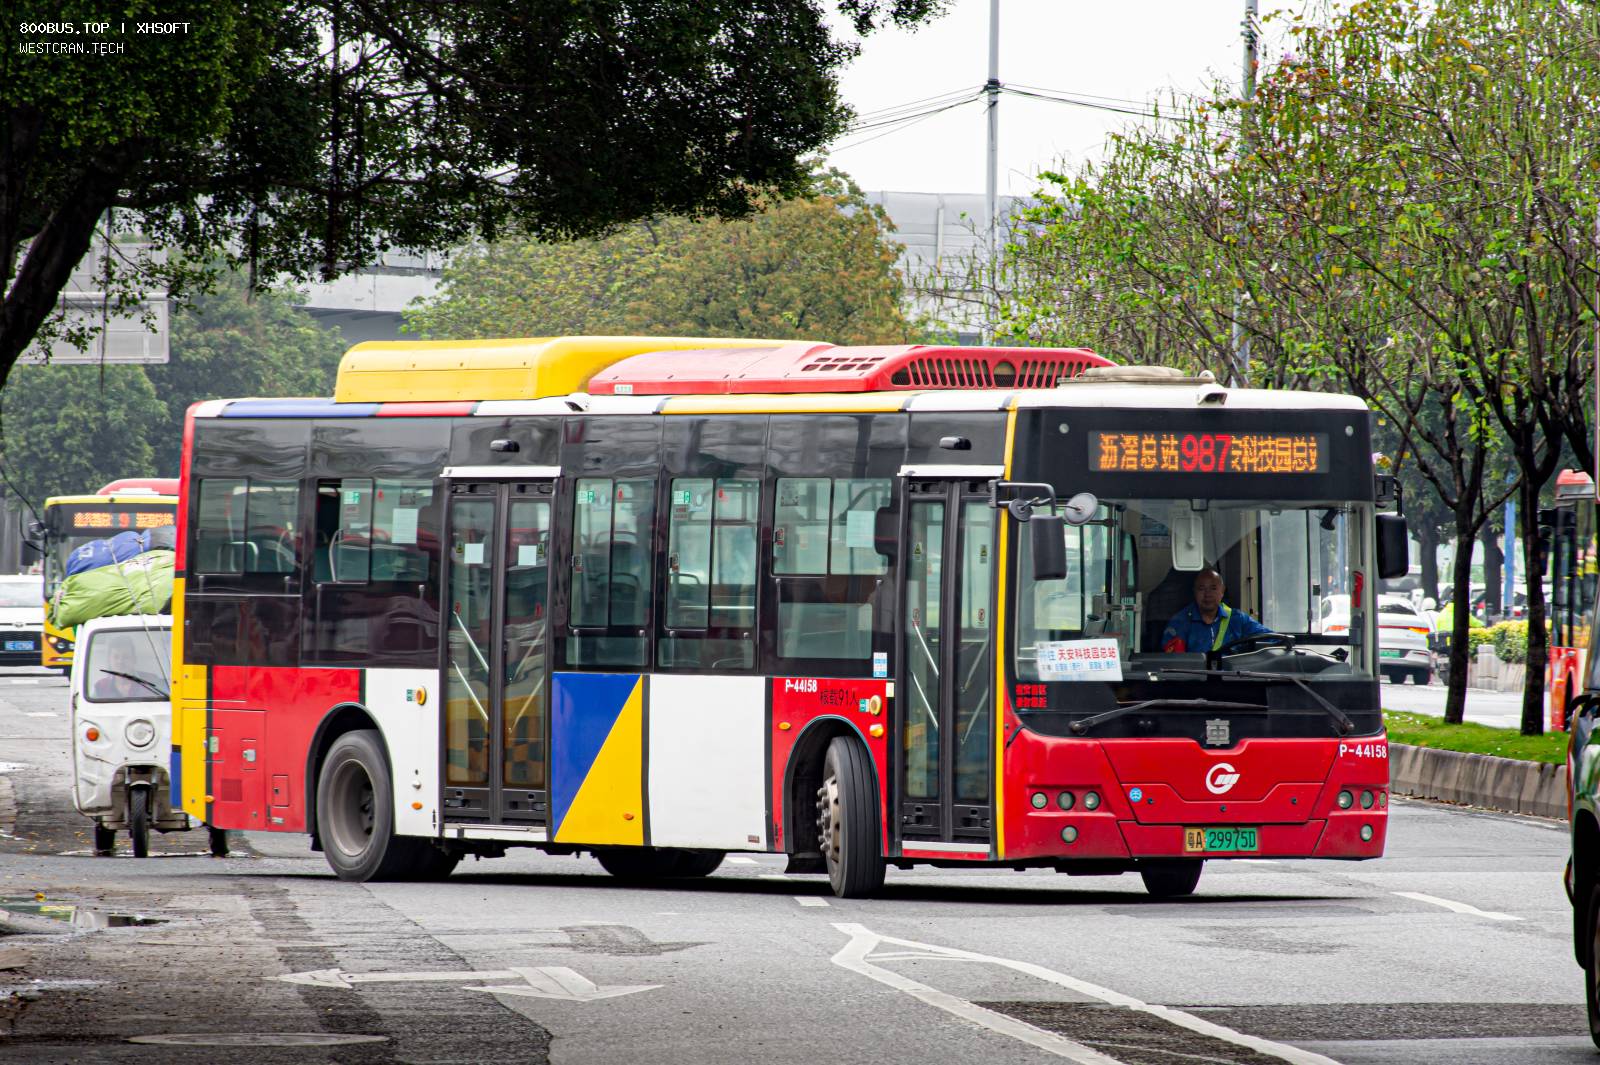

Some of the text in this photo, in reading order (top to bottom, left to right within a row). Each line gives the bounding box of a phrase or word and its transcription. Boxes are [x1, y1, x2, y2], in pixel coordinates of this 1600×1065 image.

[1181, 434, 1231, 472] 987
[785, 679, 817, 692] P-44158
[1339, 744, 1387, 758] P-44158
[1209, 831, 1256, 849] 29975D
